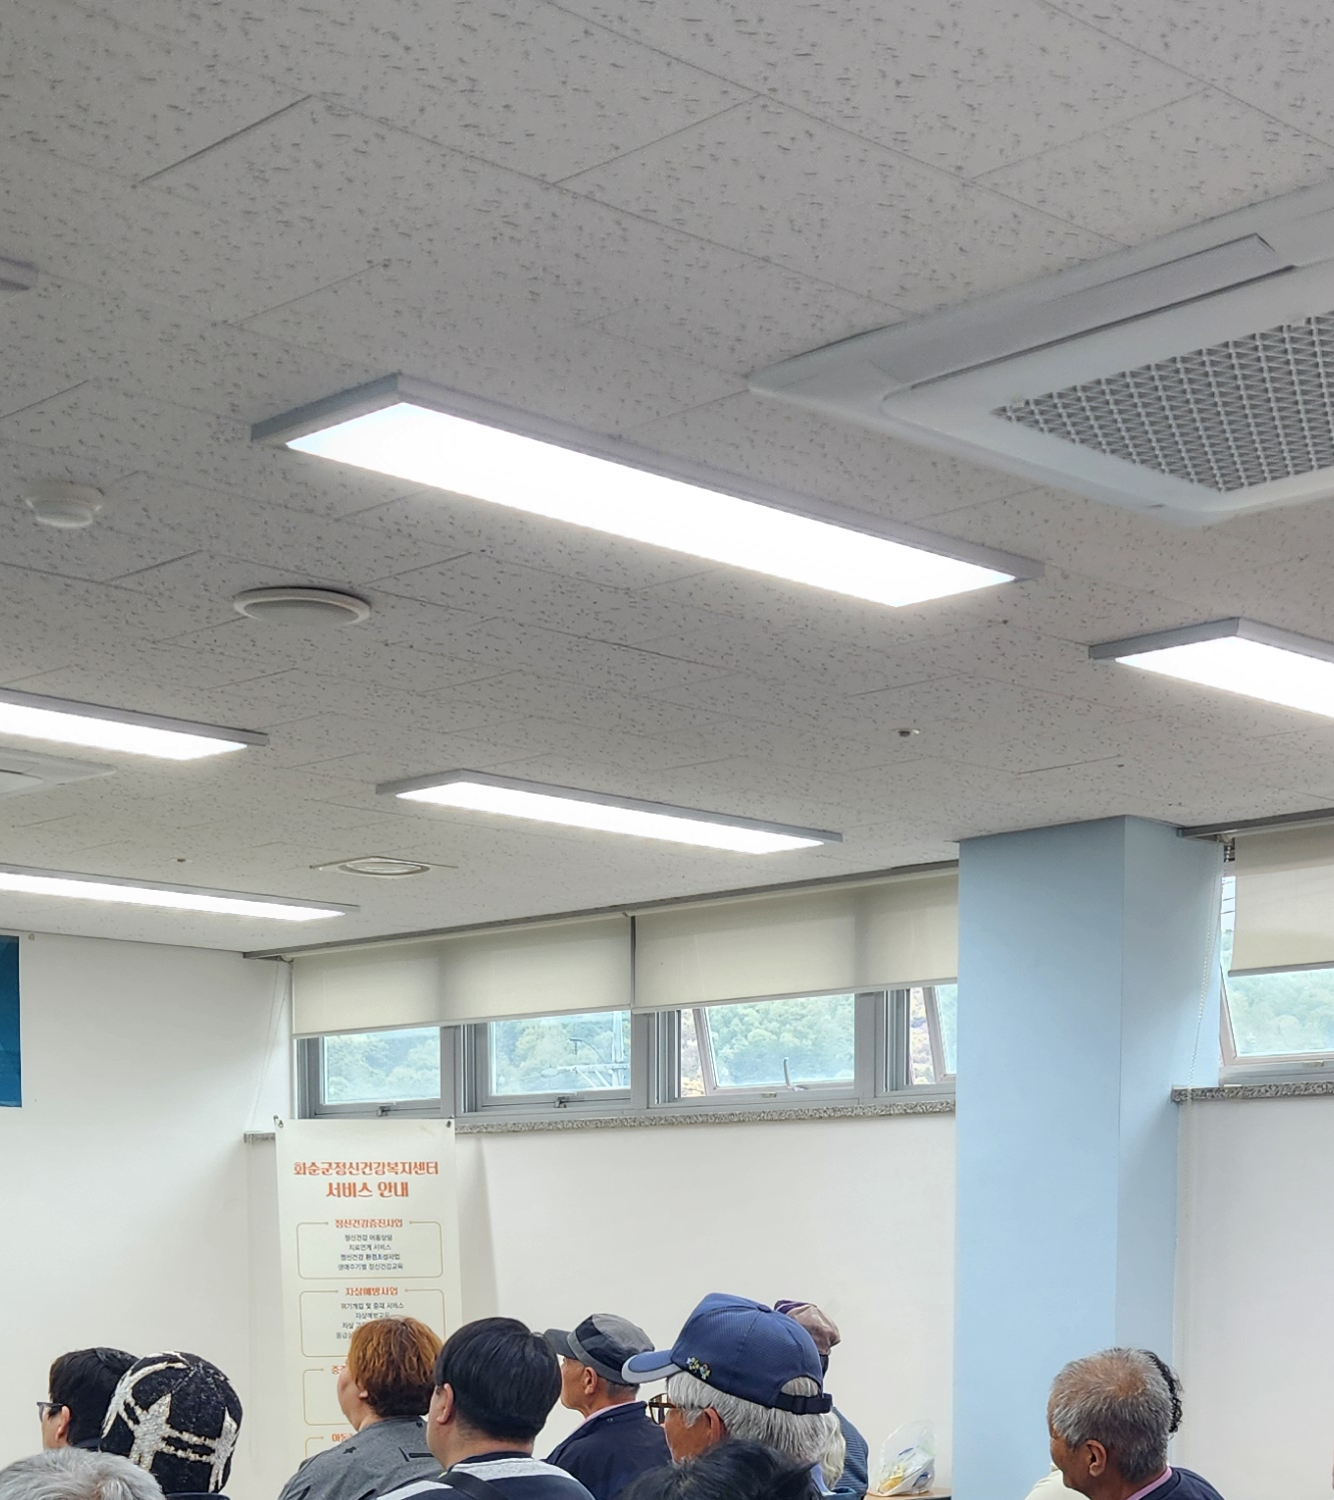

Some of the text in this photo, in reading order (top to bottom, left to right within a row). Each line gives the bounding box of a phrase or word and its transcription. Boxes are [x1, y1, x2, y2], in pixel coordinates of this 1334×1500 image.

[293, 1161, 439, 1176] 화순군정신건강복지센터
[326, 1181, 409, 1198] 서비스 안내
